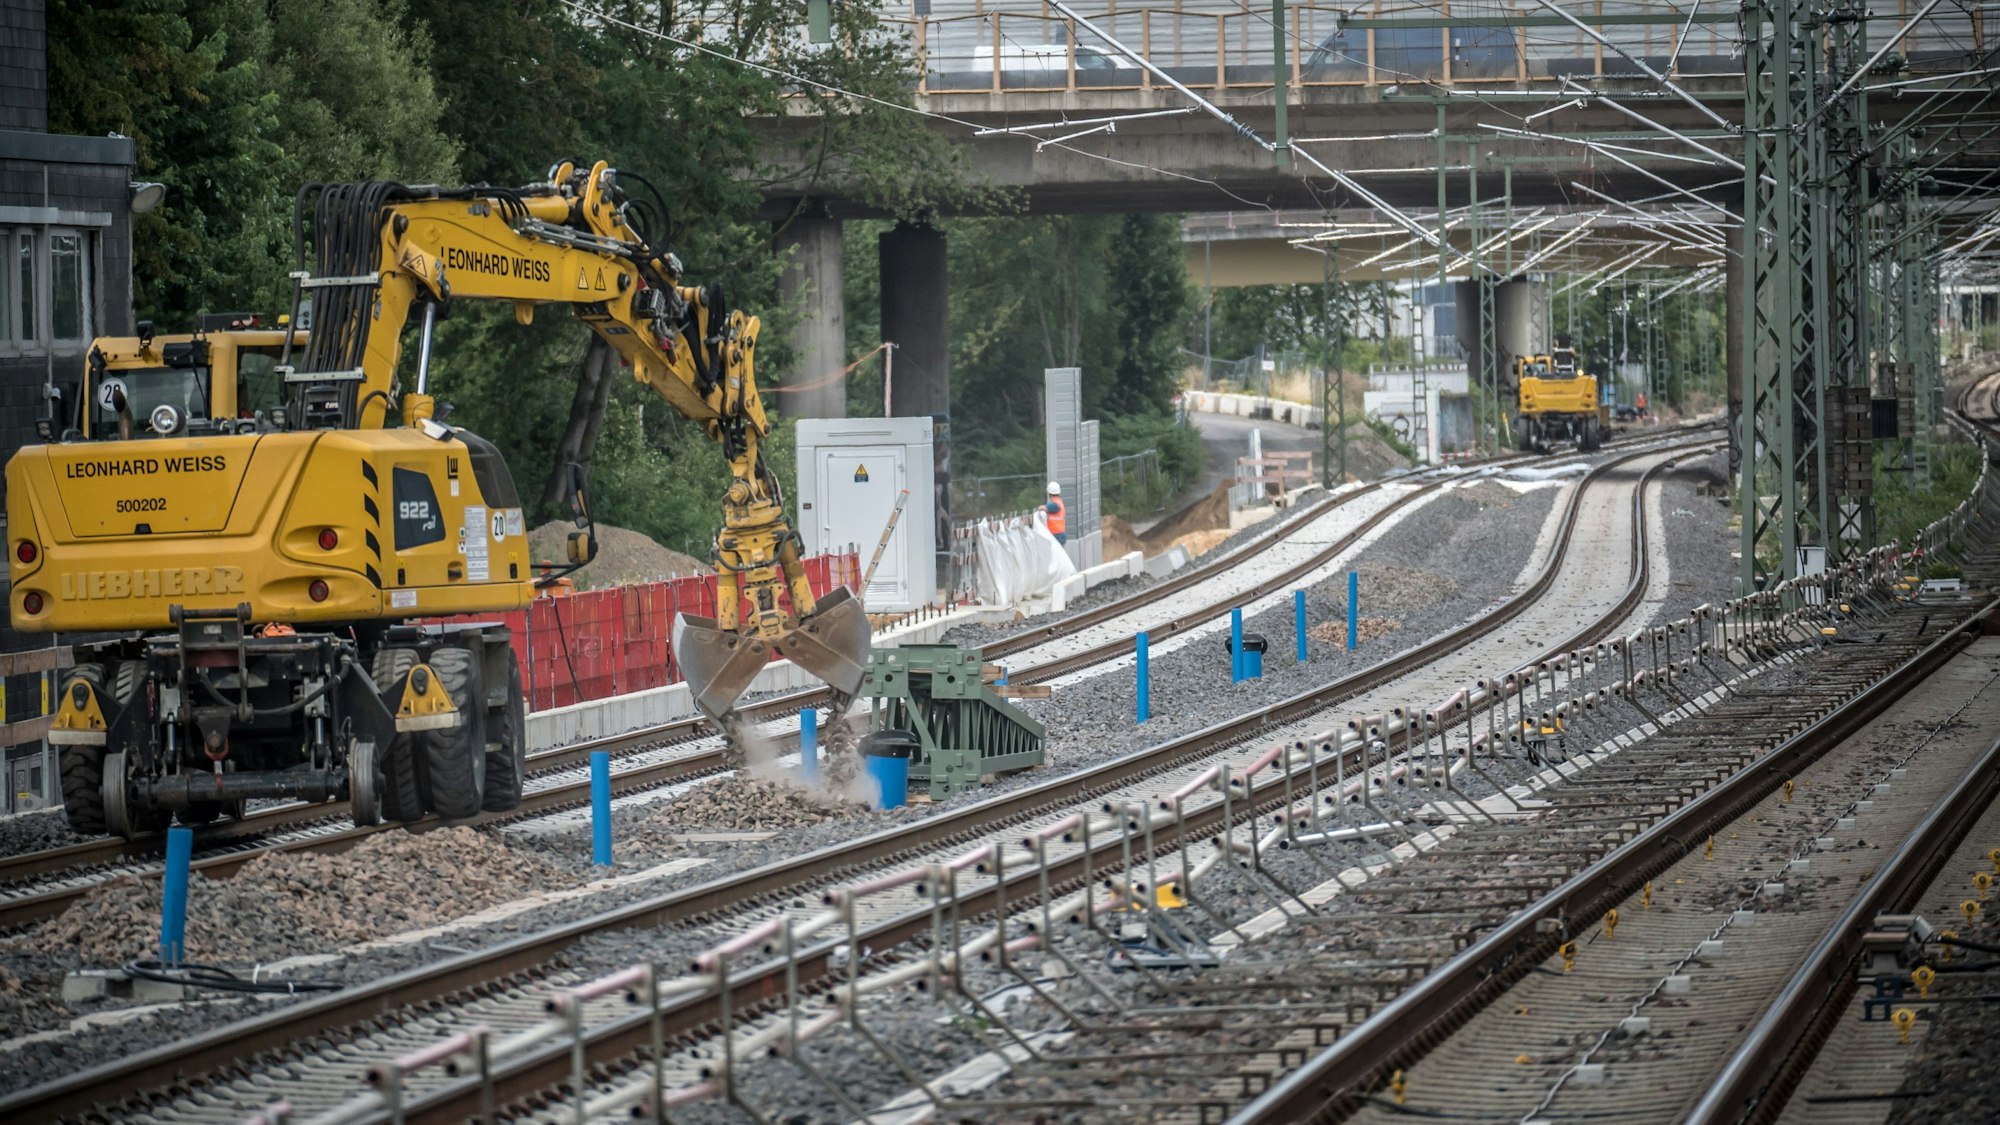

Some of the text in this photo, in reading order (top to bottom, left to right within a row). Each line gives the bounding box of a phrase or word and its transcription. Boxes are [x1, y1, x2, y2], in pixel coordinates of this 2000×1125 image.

[511, 257, 550, 282] WEISS
[67, 456, 226, 479] LEONHARD WEISS
[116, 498, 167, 513] 500202
[400, 501, 430, 519] 922
[494, 516, 504, 536] 20
[61, 566, 245, 601] LIEBHERR
